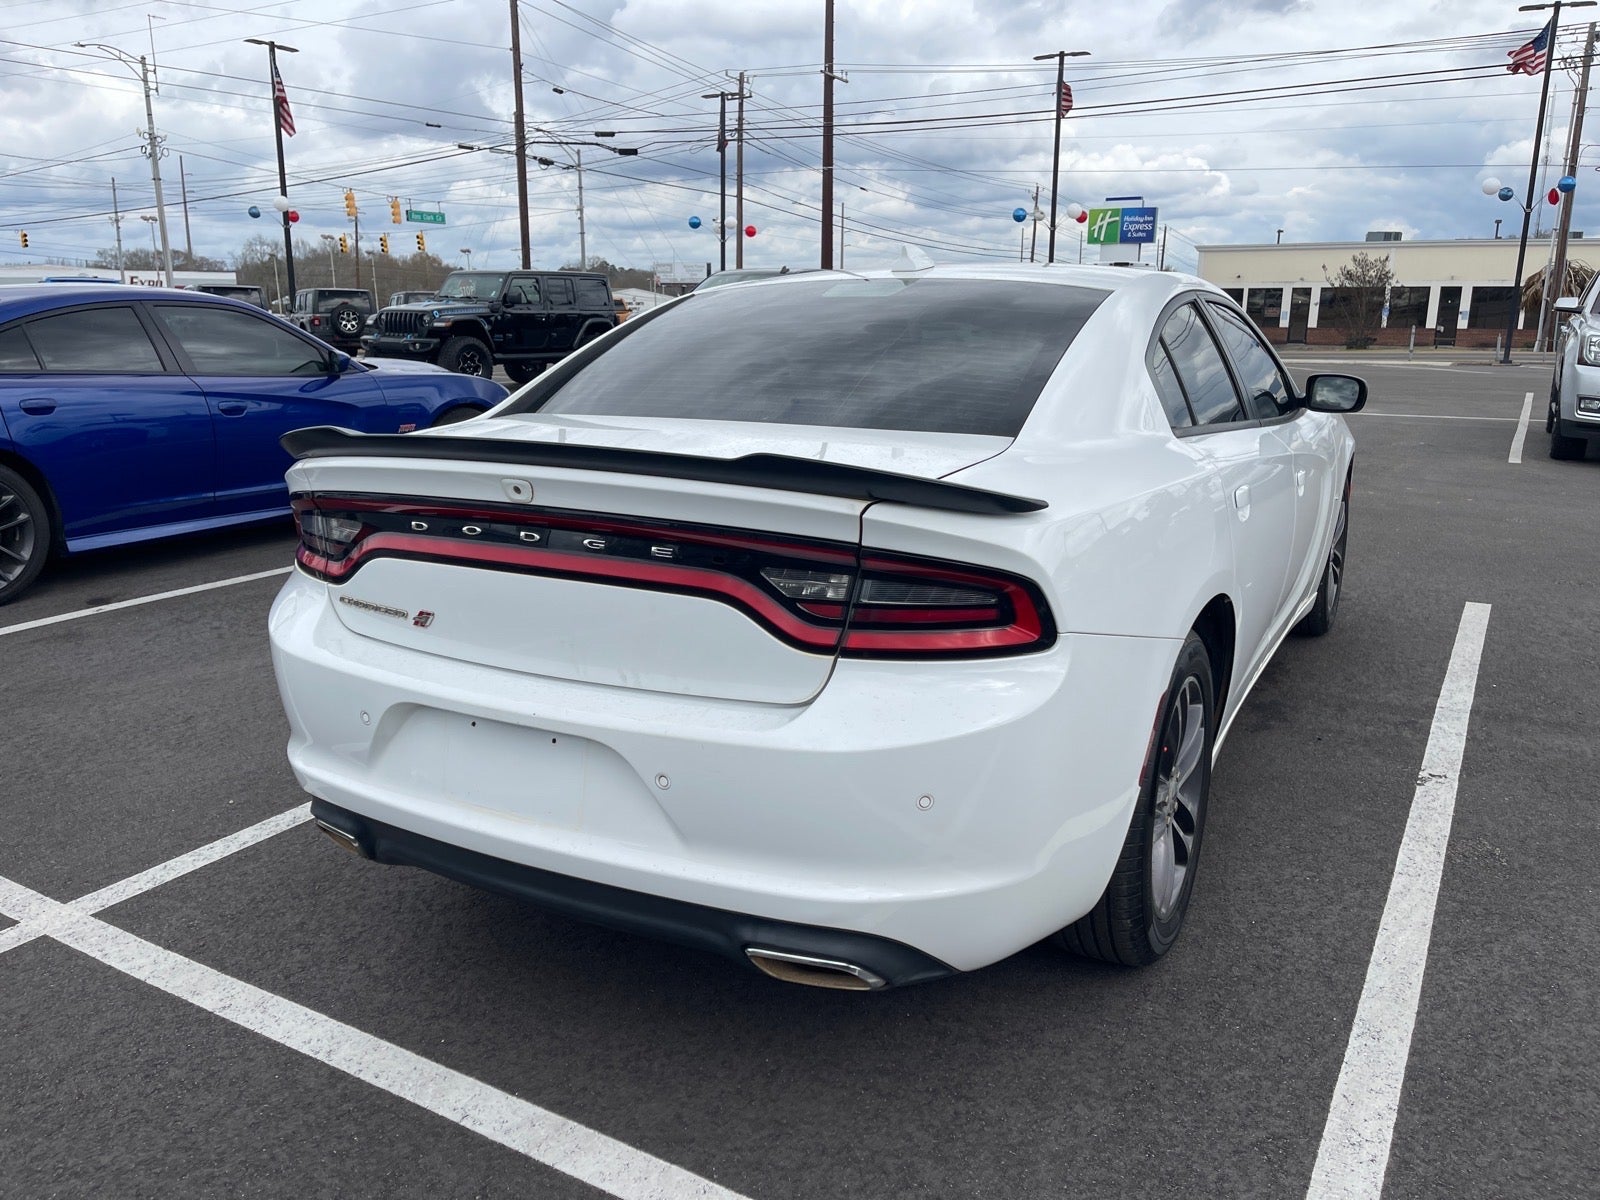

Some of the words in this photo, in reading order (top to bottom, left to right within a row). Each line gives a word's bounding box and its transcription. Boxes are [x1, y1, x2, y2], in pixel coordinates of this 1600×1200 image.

[1124, 215, 1144, 223] Holiday
[1123, 222, 1153, 232] Express
[411, 520, 673, 558] DODGE
